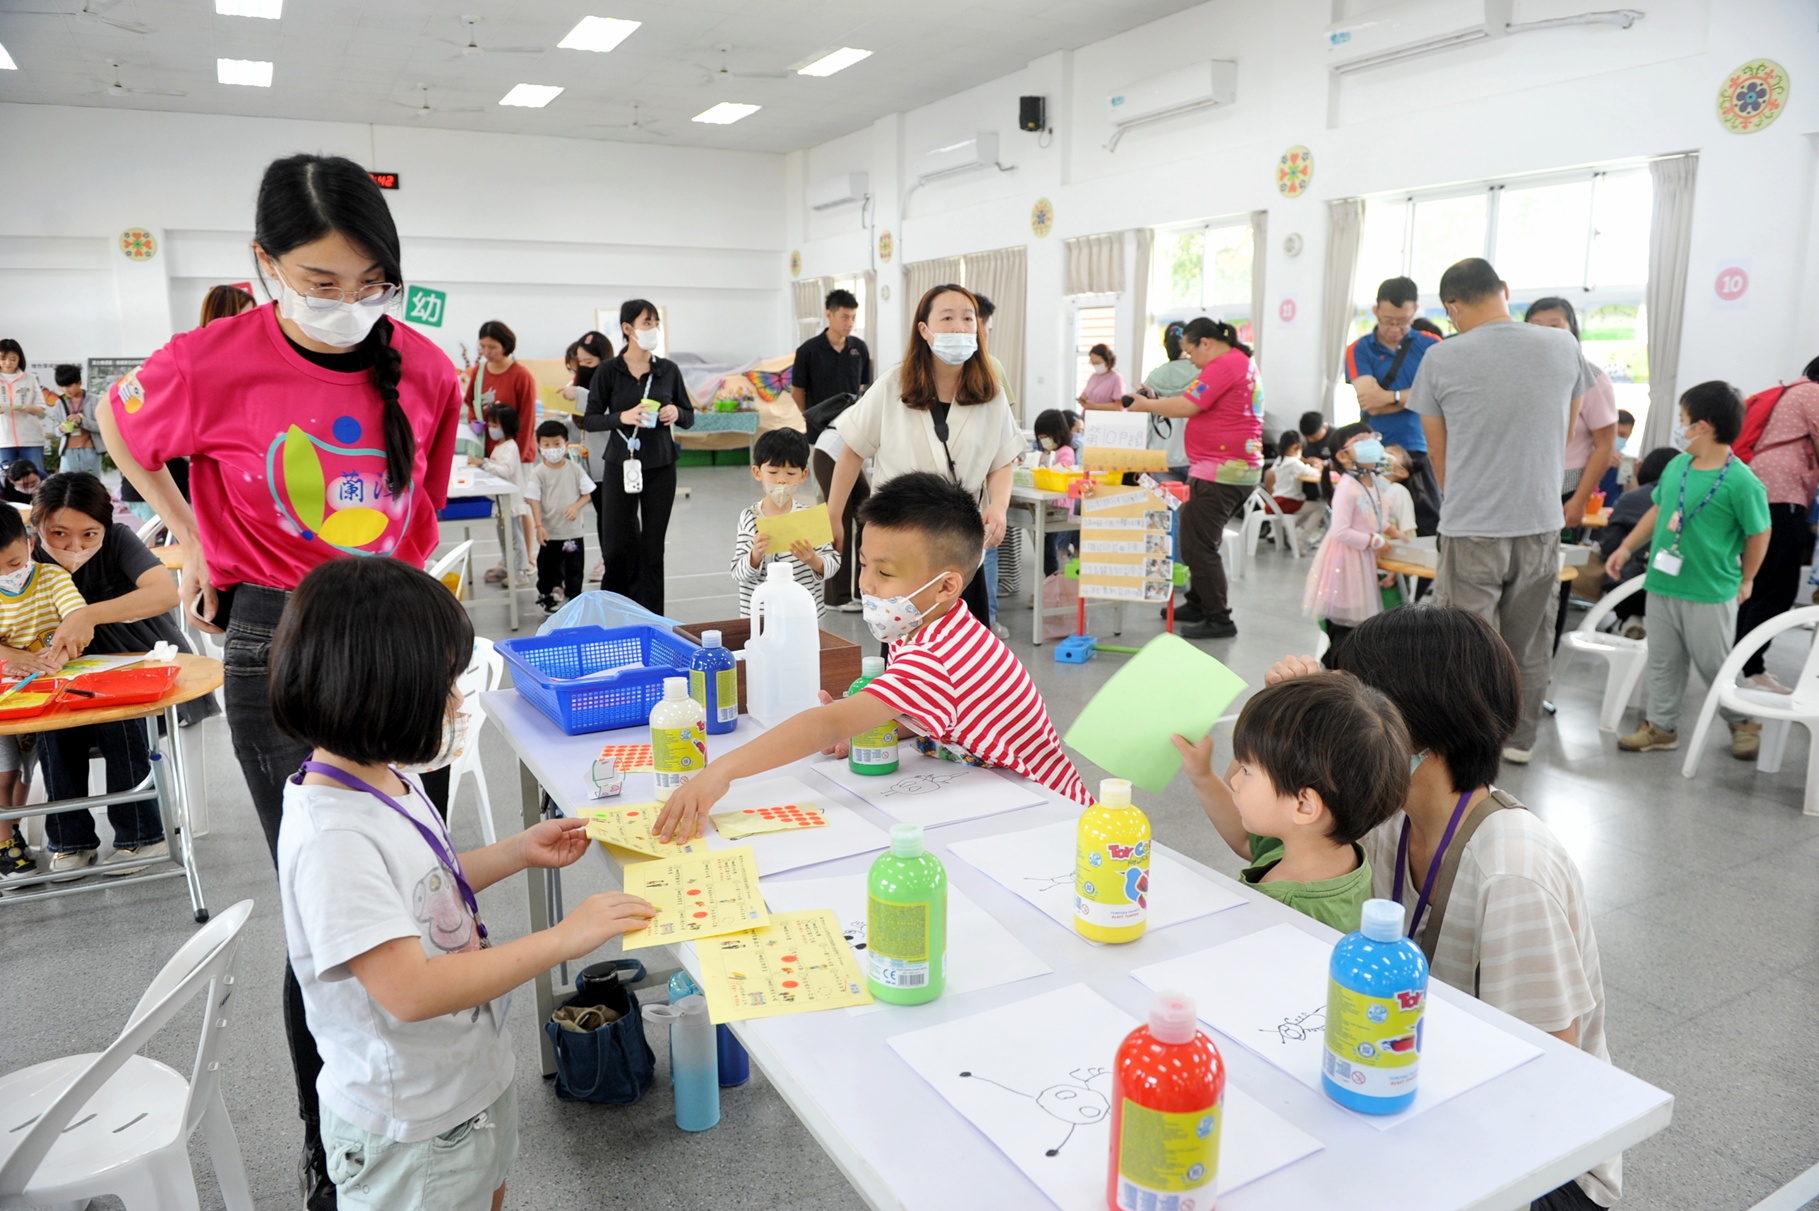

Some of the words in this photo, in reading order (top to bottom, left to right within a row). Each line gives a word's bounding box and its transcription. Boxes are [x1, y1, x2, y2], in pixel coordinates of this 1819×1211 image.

[1722, 275, 1744, 293] 10
[411, 291, 442, 323] 幼
[1282, 304, 1292, 317] 11
